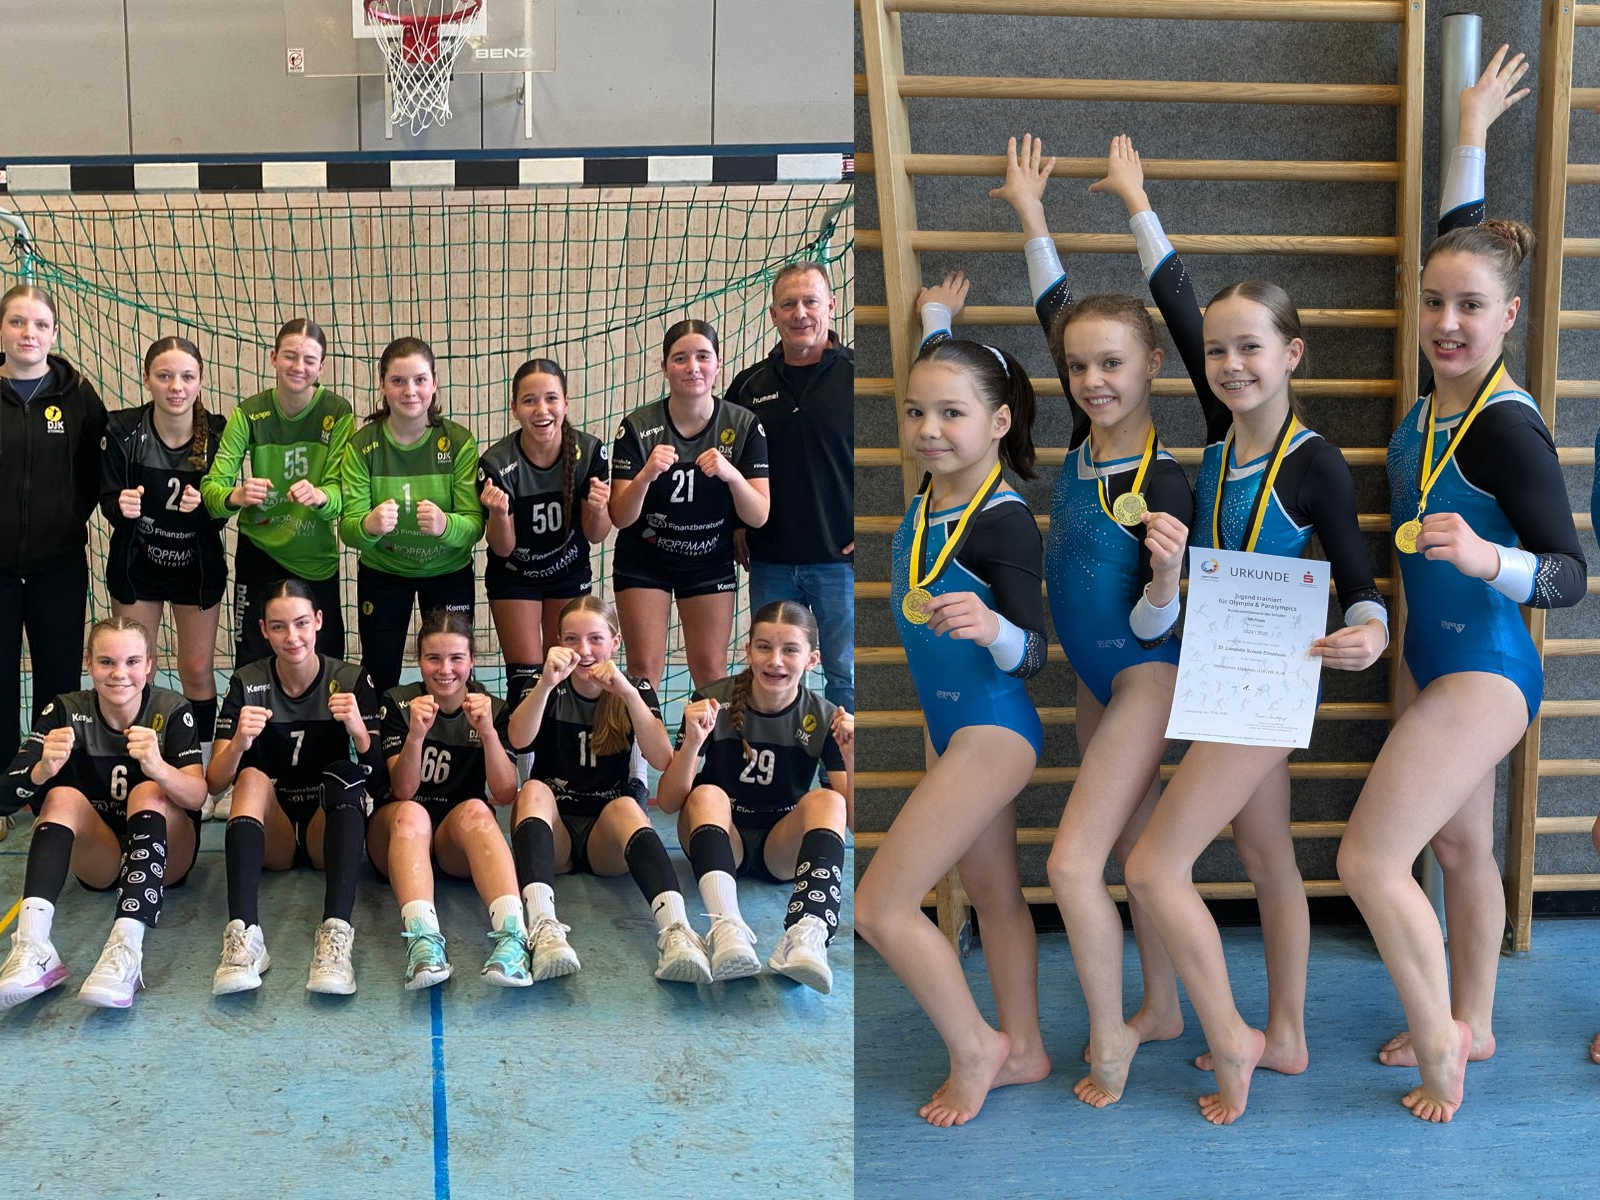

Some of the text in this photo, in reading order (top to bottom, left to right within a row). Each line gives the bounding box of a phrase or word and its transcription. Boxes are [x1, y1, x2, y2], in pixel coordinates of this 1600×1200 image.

[475, 48, 533, 59] BENZ
[47, 421, 64, 430] DJK
[640, 425, 665, 439] Kempa
[284, 447, 309, 480] 55
[165, 477, 181, 511] 2
[402, 483, 411, 514] 1
[670, 469, 695, 503] 21
[532, 501, 563, 535] 50
[1230, 567, 1290, 583] URKUNDE
[1229, 599, 1254, 607] Olympia
[1260, 602, 1297, 611] Paralympics
[1234, 593, 1282, 603] Jugend trainiert
[290, 730, 305, 766] 7
[469, 729, 481, 739] DJ
[420, 746, 452, 784] 66
[739, 749, 776, 786] 29
[111, 764, 128, 800] 6
